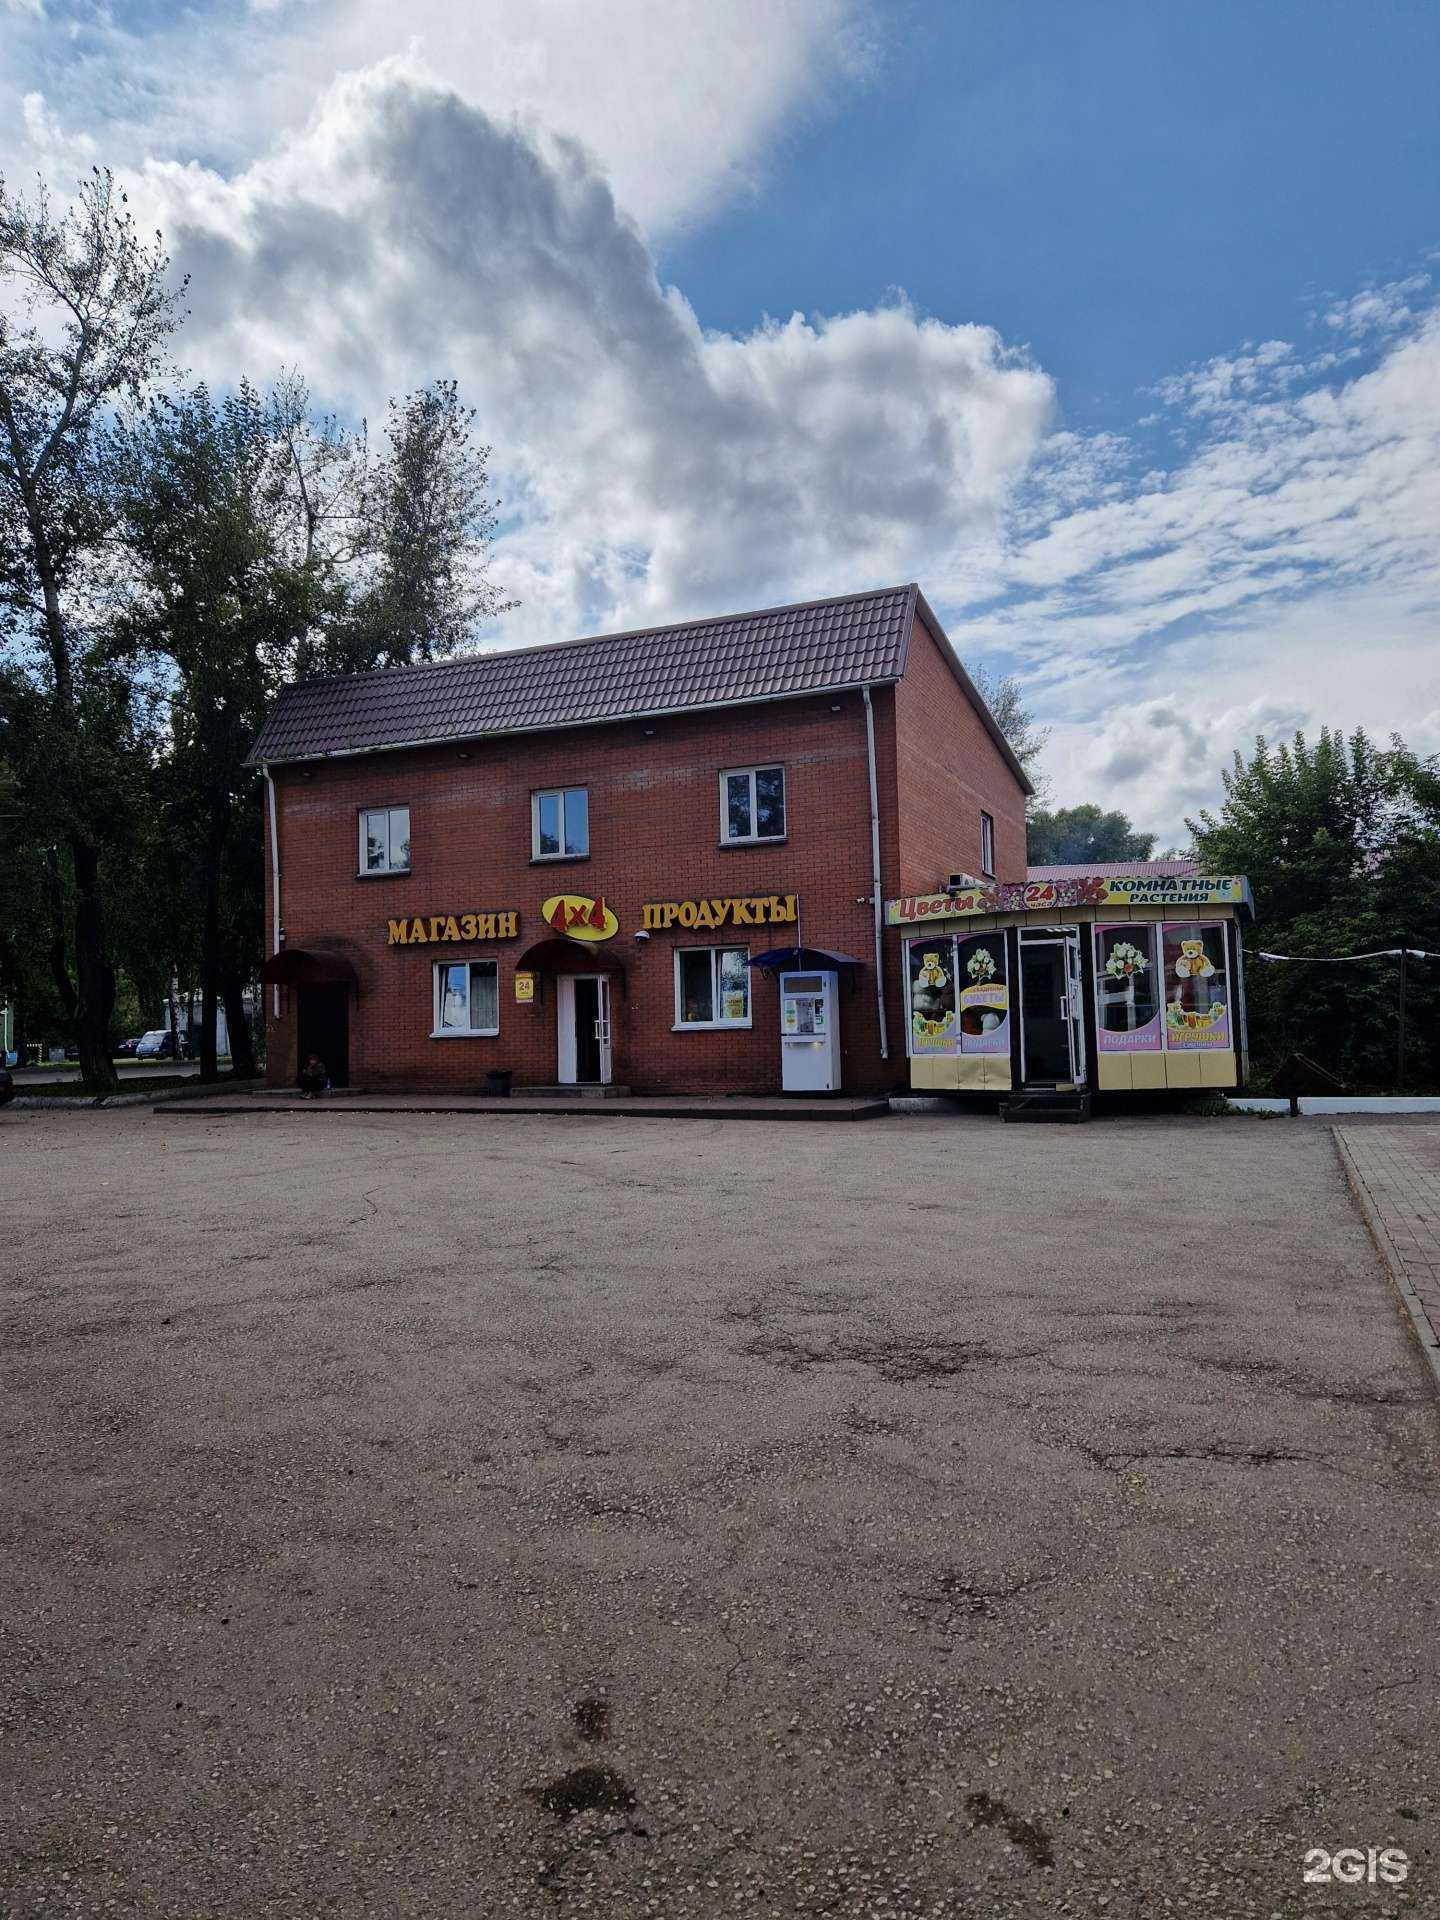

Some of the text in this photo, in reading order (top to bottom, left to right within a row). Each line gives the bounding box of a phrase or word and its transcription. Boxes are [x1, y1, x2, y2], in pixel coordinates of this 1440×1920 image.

[1026, 885, 1054, 902] 24
[1109, 879, 1232, 892] КОМНАТНЫЕ
[899, 894, 974, 921] Цветы
[1129, 892, 1209, 903] РАСТЕНИЯ
[642, 894, 798, 930] ПРОДУКТЫ
[387, 911, 518, 945] МАГАЗИН
